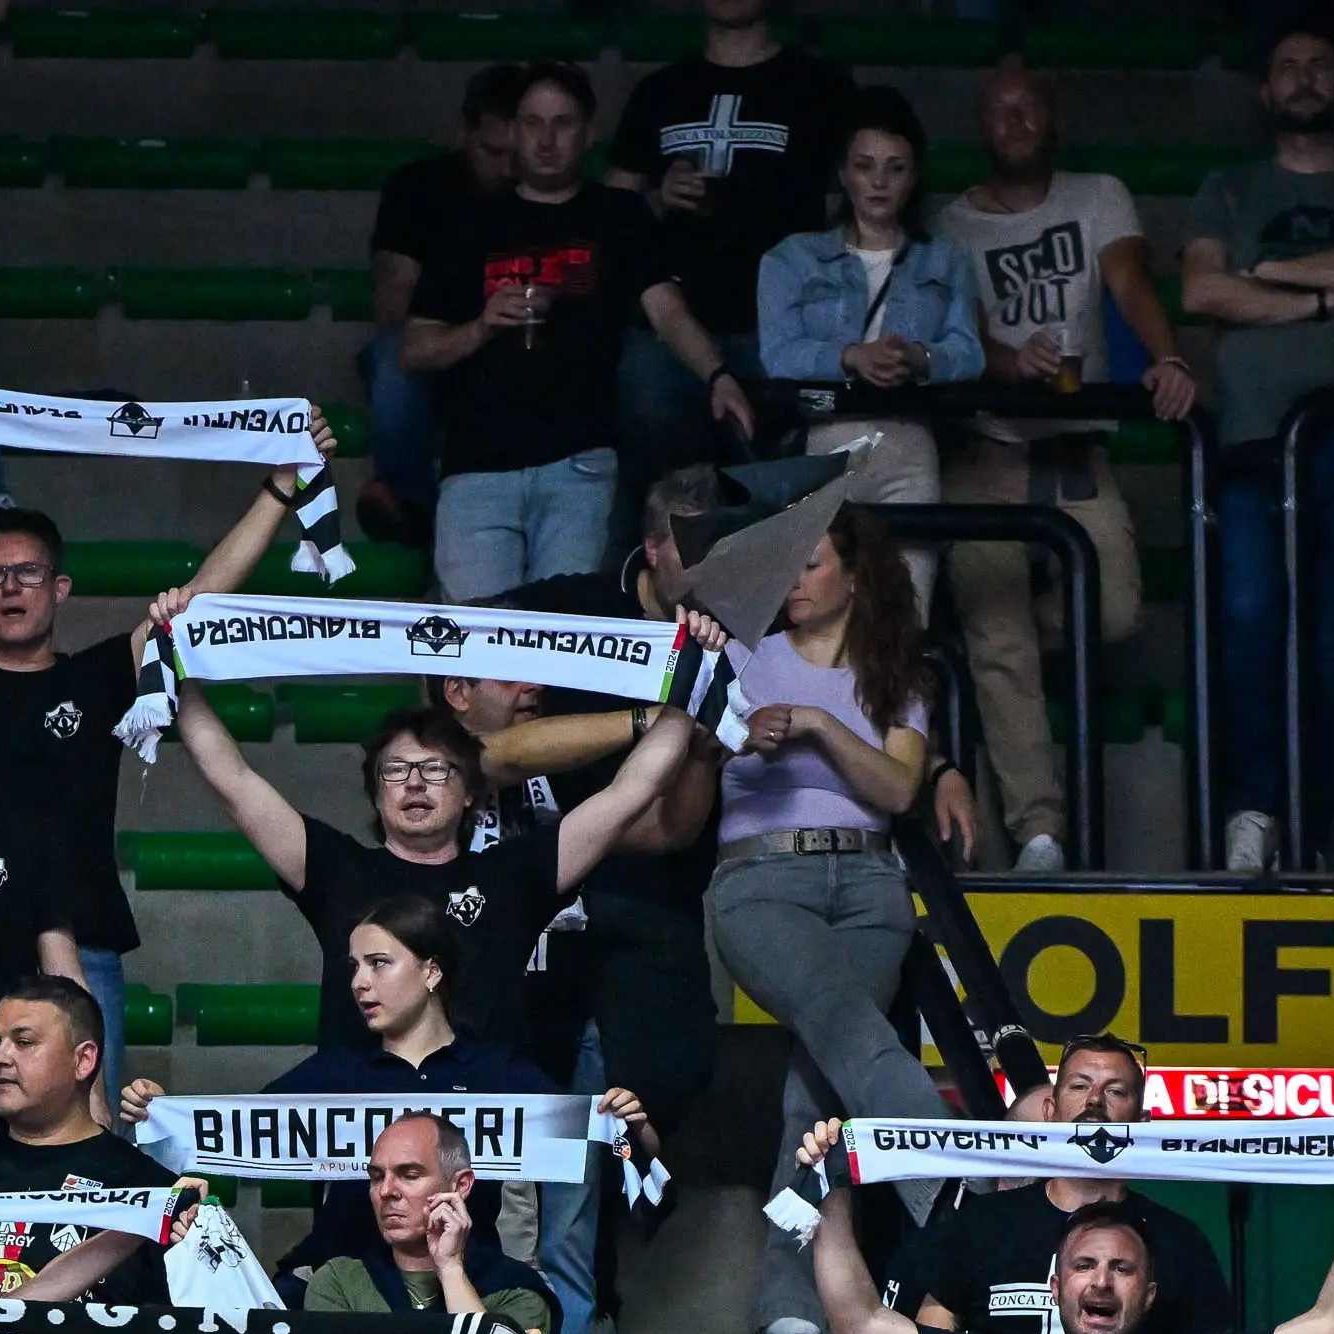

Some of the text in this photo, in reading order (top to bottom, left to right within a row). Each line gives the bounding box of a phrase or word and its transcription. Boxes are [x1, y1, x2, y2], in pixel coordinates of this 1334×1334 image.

[186, 615, 381, 648] BIANCONERA
[843, 1127, 857, 1152] 2024
[990, 1294, 1035, 1308] CONCA
